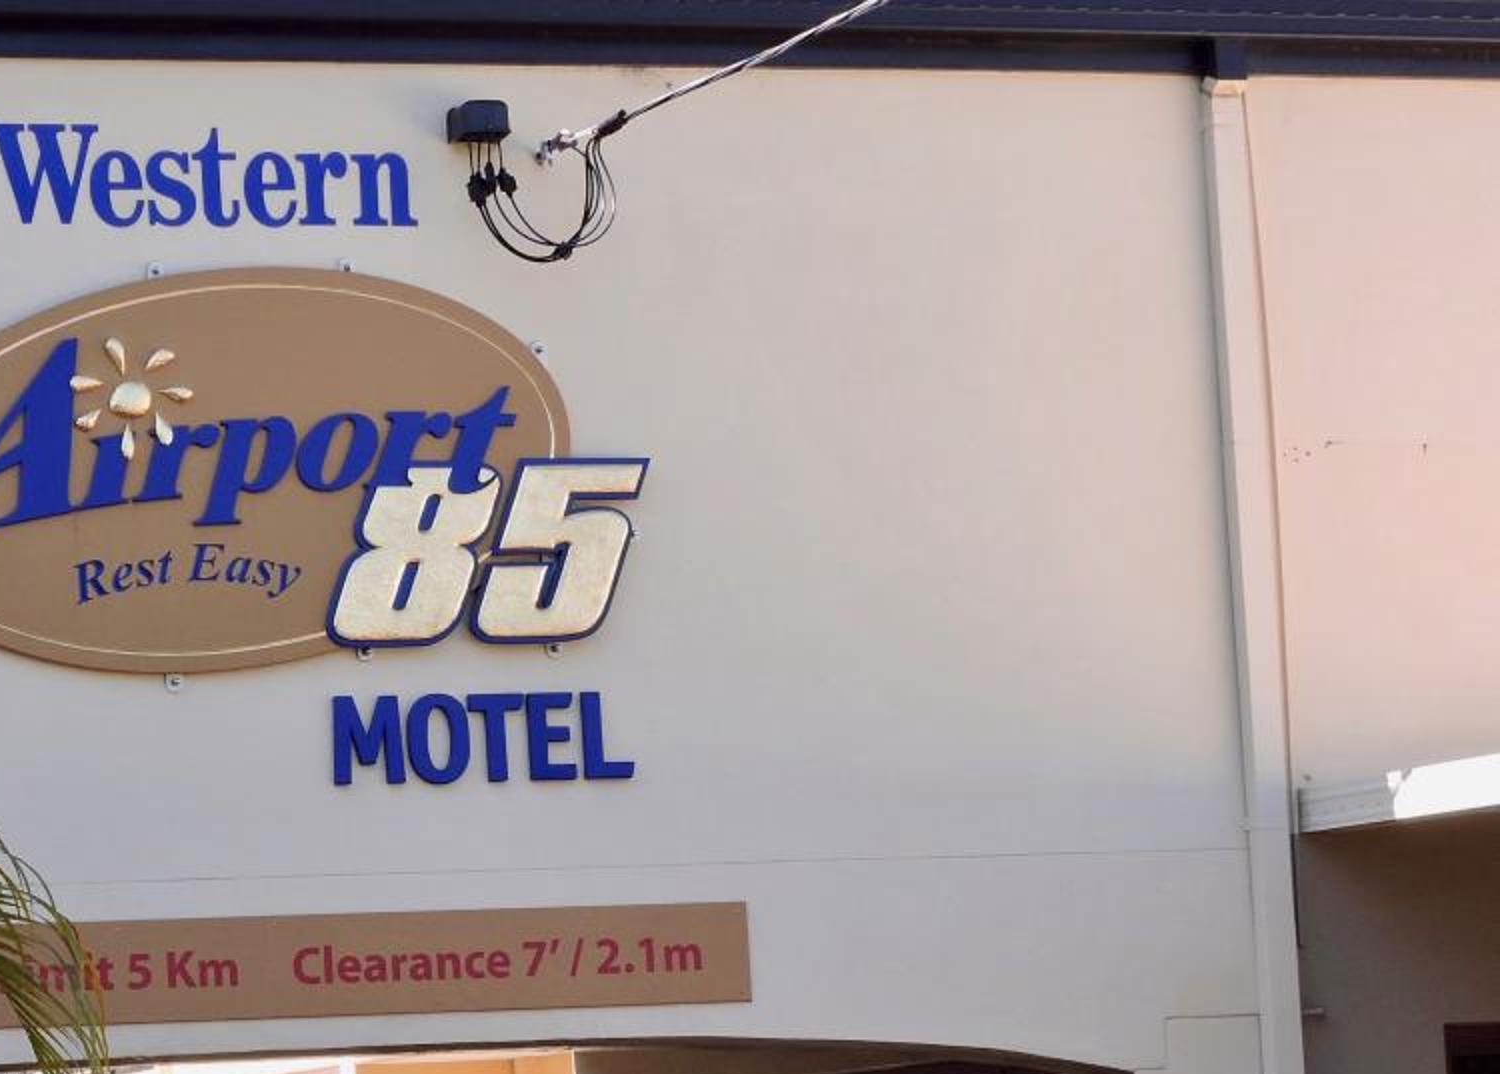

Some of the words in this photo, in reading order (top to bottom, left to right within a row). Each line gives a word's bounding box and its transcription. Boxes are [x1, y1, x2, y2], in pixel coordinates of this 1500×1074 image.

[74, 549, 173, 606] Rest
[189, 543, 302, 599] Easy
[325, 456, 651, 648] 85
[332, 691, 636, 787] MOTEL
[127, 953, 152, 990] 5
[167, 950, 240, 990] Km
[292, 945, 511, 985] Clearance
[597, 937, 703, 975] 2.1m
